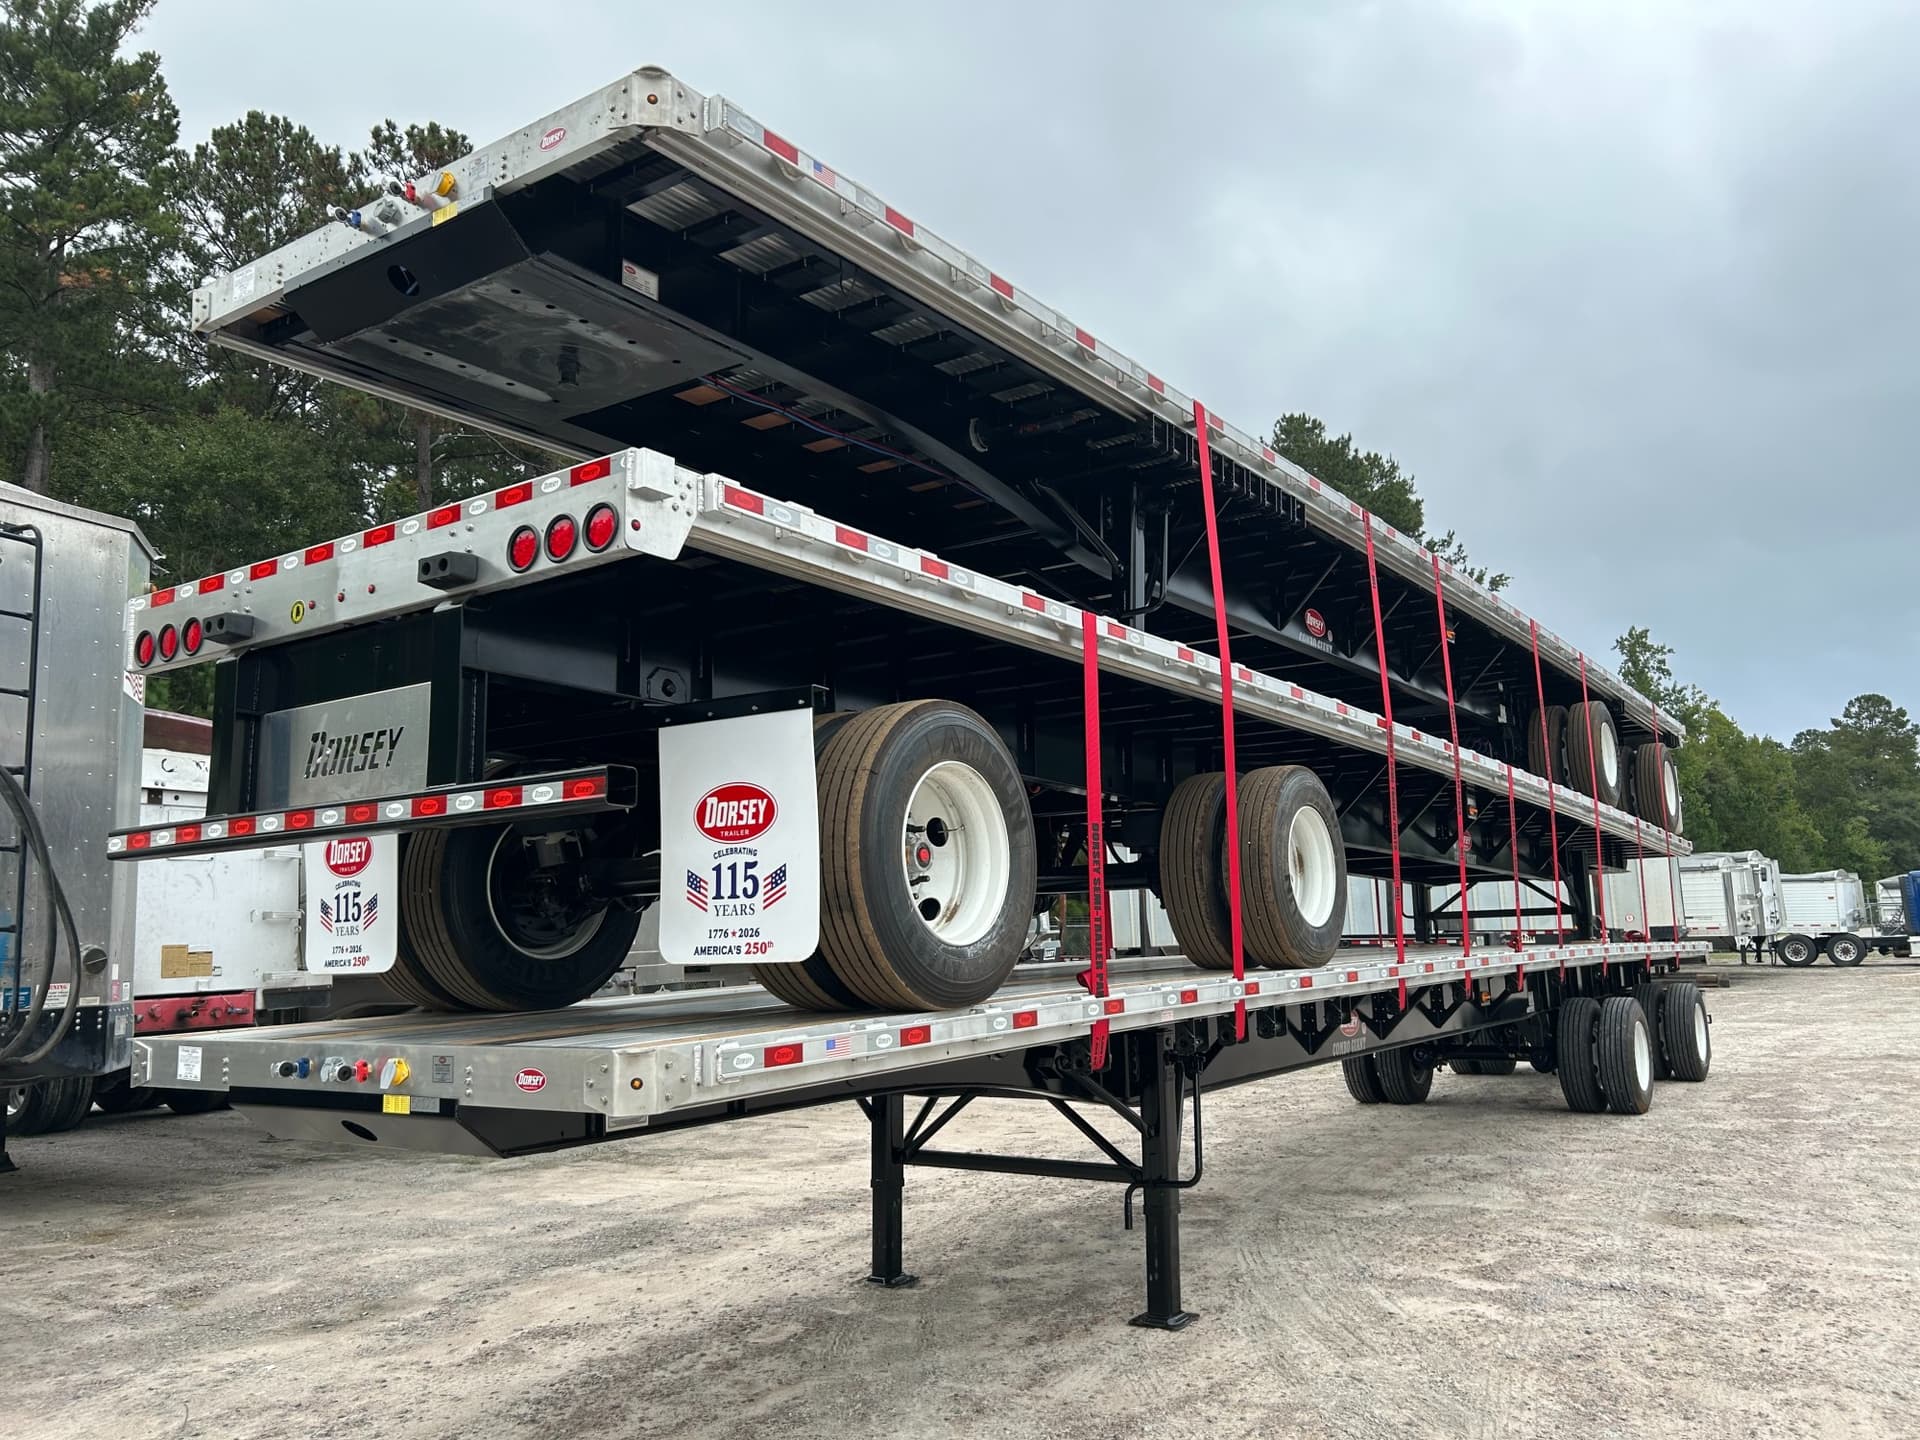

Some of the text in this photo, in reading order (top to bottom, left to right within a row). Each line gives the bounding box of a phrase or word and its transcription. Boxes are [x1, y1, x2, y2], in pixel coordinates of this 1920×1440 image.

[304, 726, 405, 779] DORSEY
[703, 796, 768, 829] DORSEY
[720, 829, 750, 838] TRAILER
[329, 839, 369, 866] DORSEY
[713, 847, 758, 860] CELEBRATING
[1091, 823, 1102, 874] DORSEY
[711, 860, 760, 901] 115
[334, 891, 362, 924] 115
[714, 903, 756, 917] YEARS
[335, 925, 360, 937] YEARS
[708, 927, 760, 939] 1776 2026
[1092, 877, 1104, 969] SEMI-TRAILER
[332, 945, 345, 954] 1776
[693, 940, 774, 956] AMERICA'S 250th
